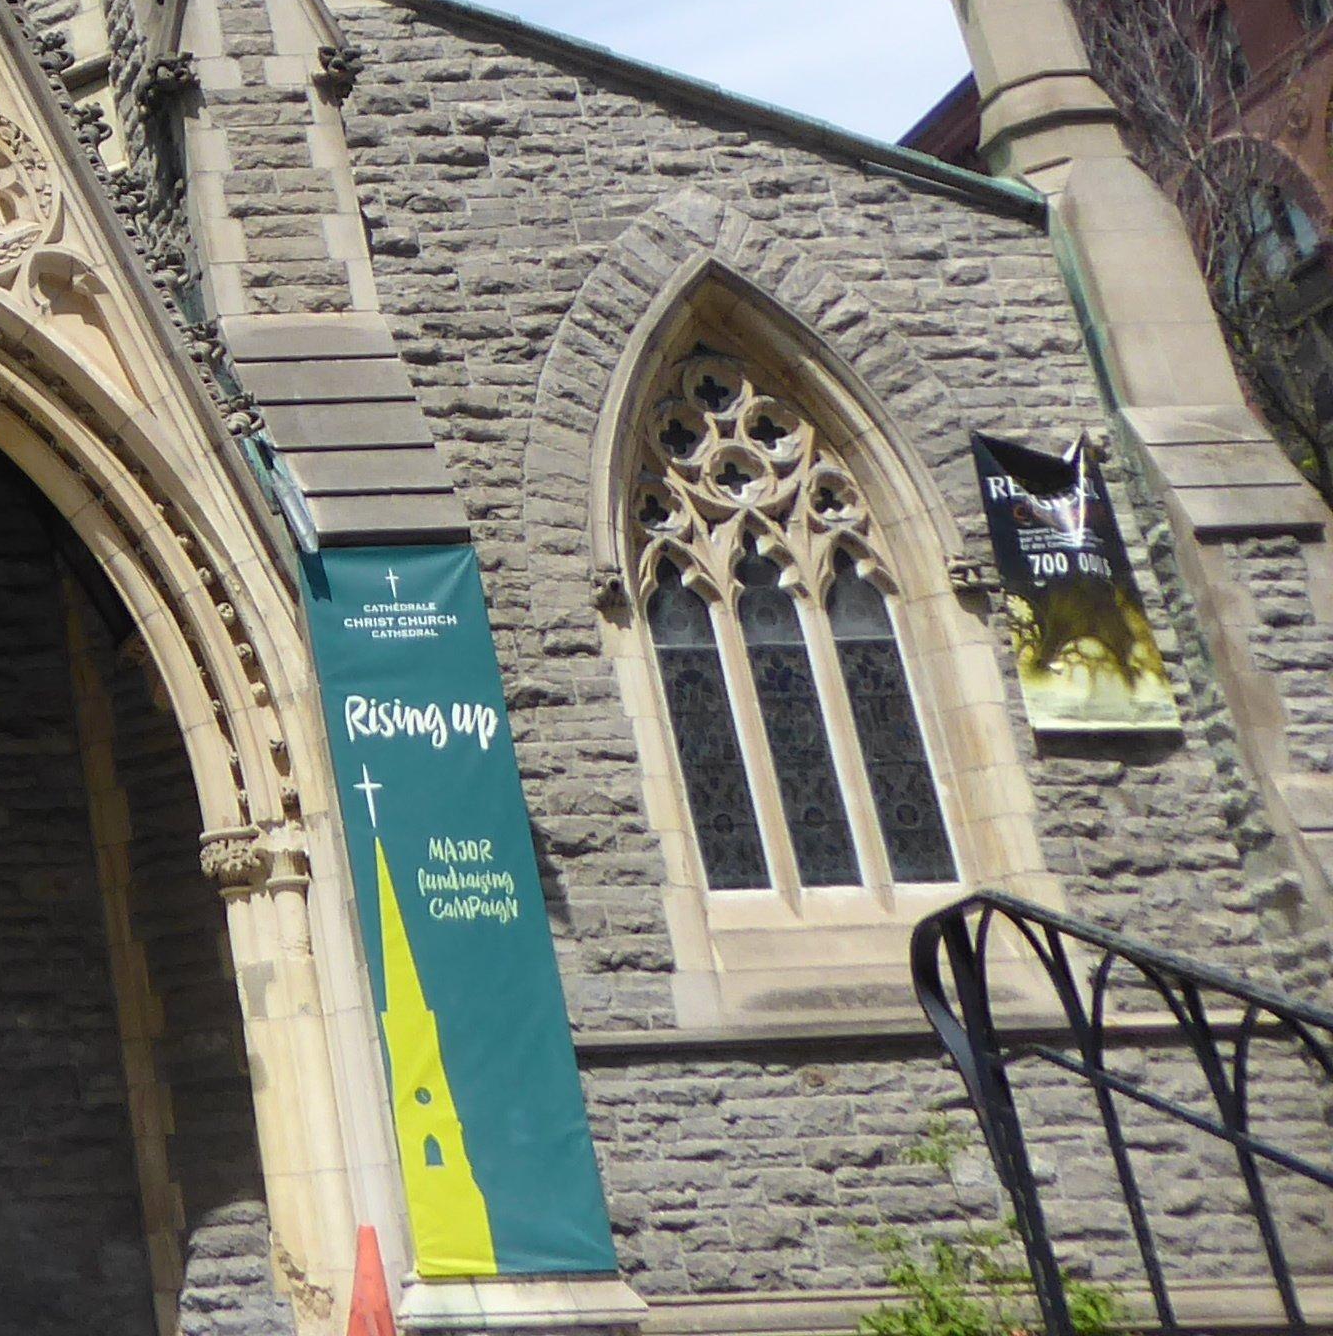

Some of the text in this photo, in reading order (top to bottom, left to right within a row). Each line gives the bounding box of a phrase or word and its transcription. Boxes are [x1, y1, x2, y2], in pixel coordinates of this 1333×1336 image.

[1028, 552, 1068, 576] 700
[343, 614, 458, 628] CHRIST CHURCH
[371, 628, 439, 638] CATHEDRAL
[345, 695, 498, 750] Rising up
[428, 836, 493, 864] MAJOR
[417, 865, 514, 897] fundraising
